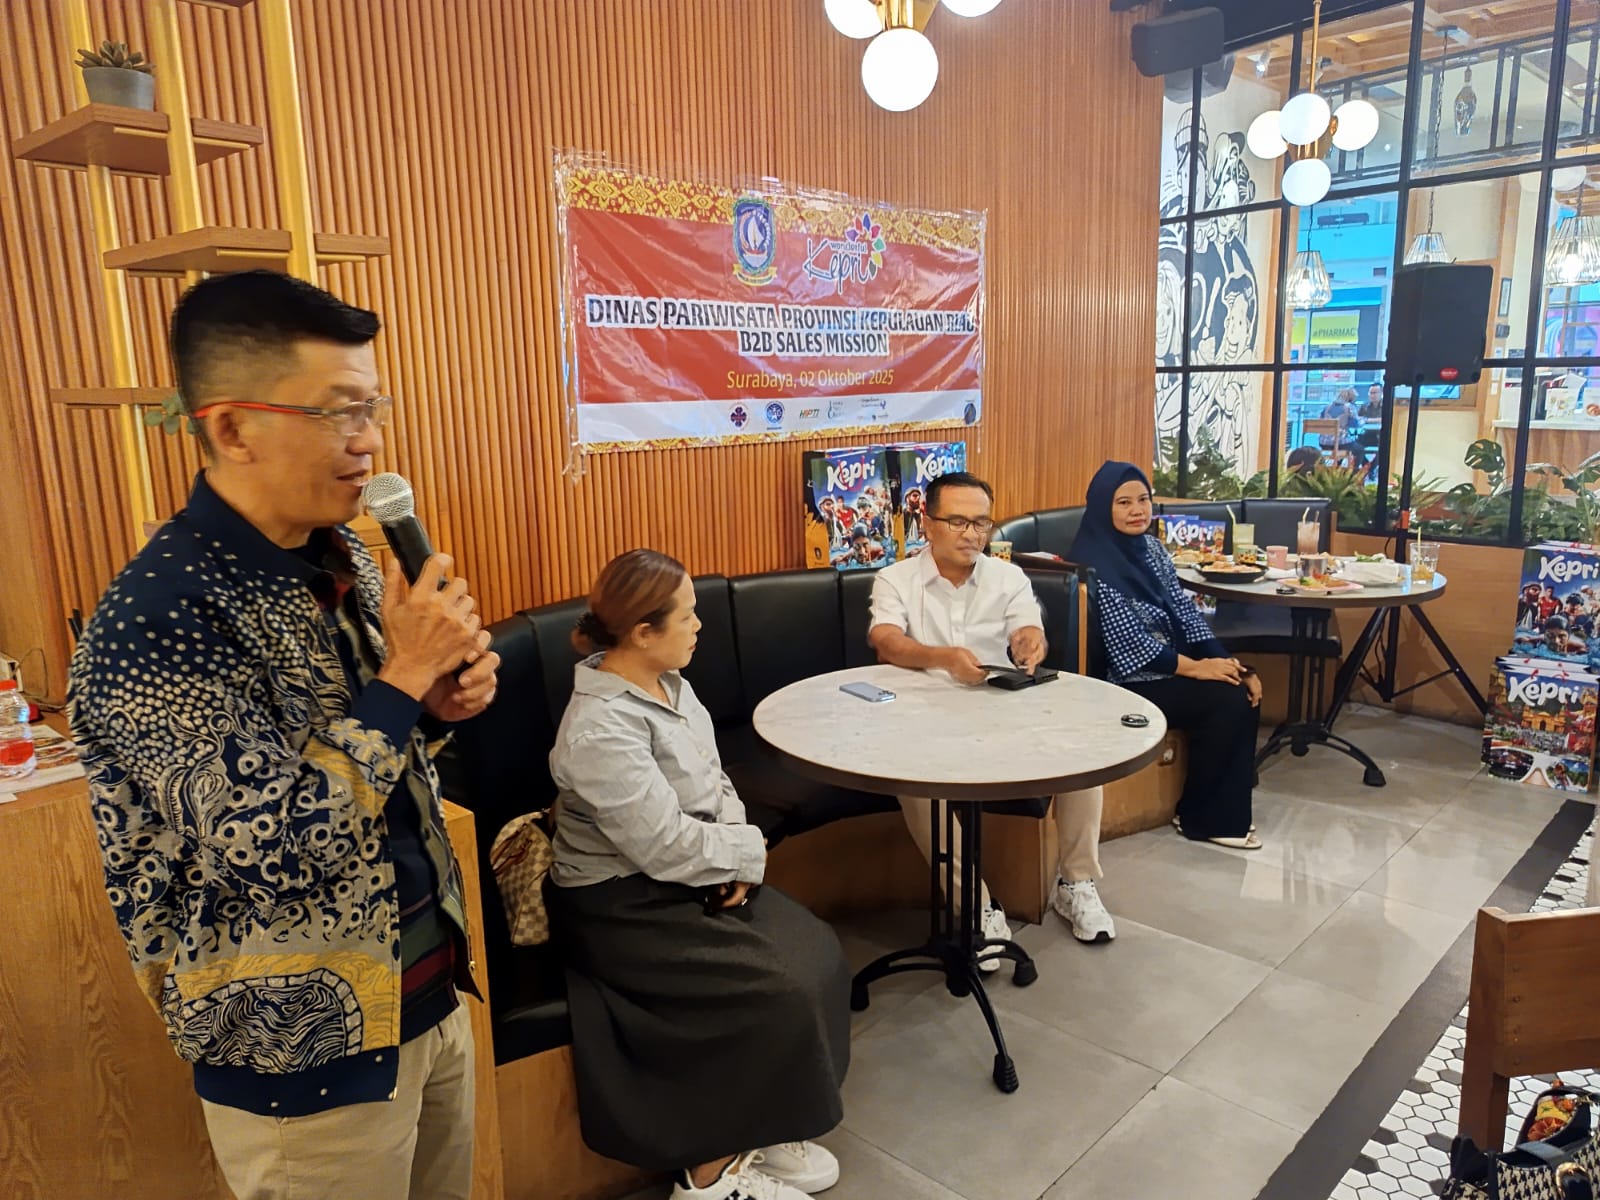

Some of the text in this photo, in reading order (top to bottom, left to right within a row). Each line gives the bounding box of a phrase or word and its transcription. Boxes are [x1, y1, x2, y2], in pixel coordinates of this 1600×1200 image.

[804, 239, 870, 293] Kepri
[588, 298, 975, 333] DINAS PARIWISATA PROVINSI KEPULAUAN RIAU
[741, 330, 888, 353] B2B SALES MISSION
[726, 369, 894, 392] Surabaya, 02 Oktober 2025
[827, 458, 876, 492] Kepri
[915, 449, 958, 484] Kepri
[1166, 520, 1213, 546] Kepri
[1538, 555, 1599, 583] Kepri
[1507, 676, 1580, 706] Kepri
